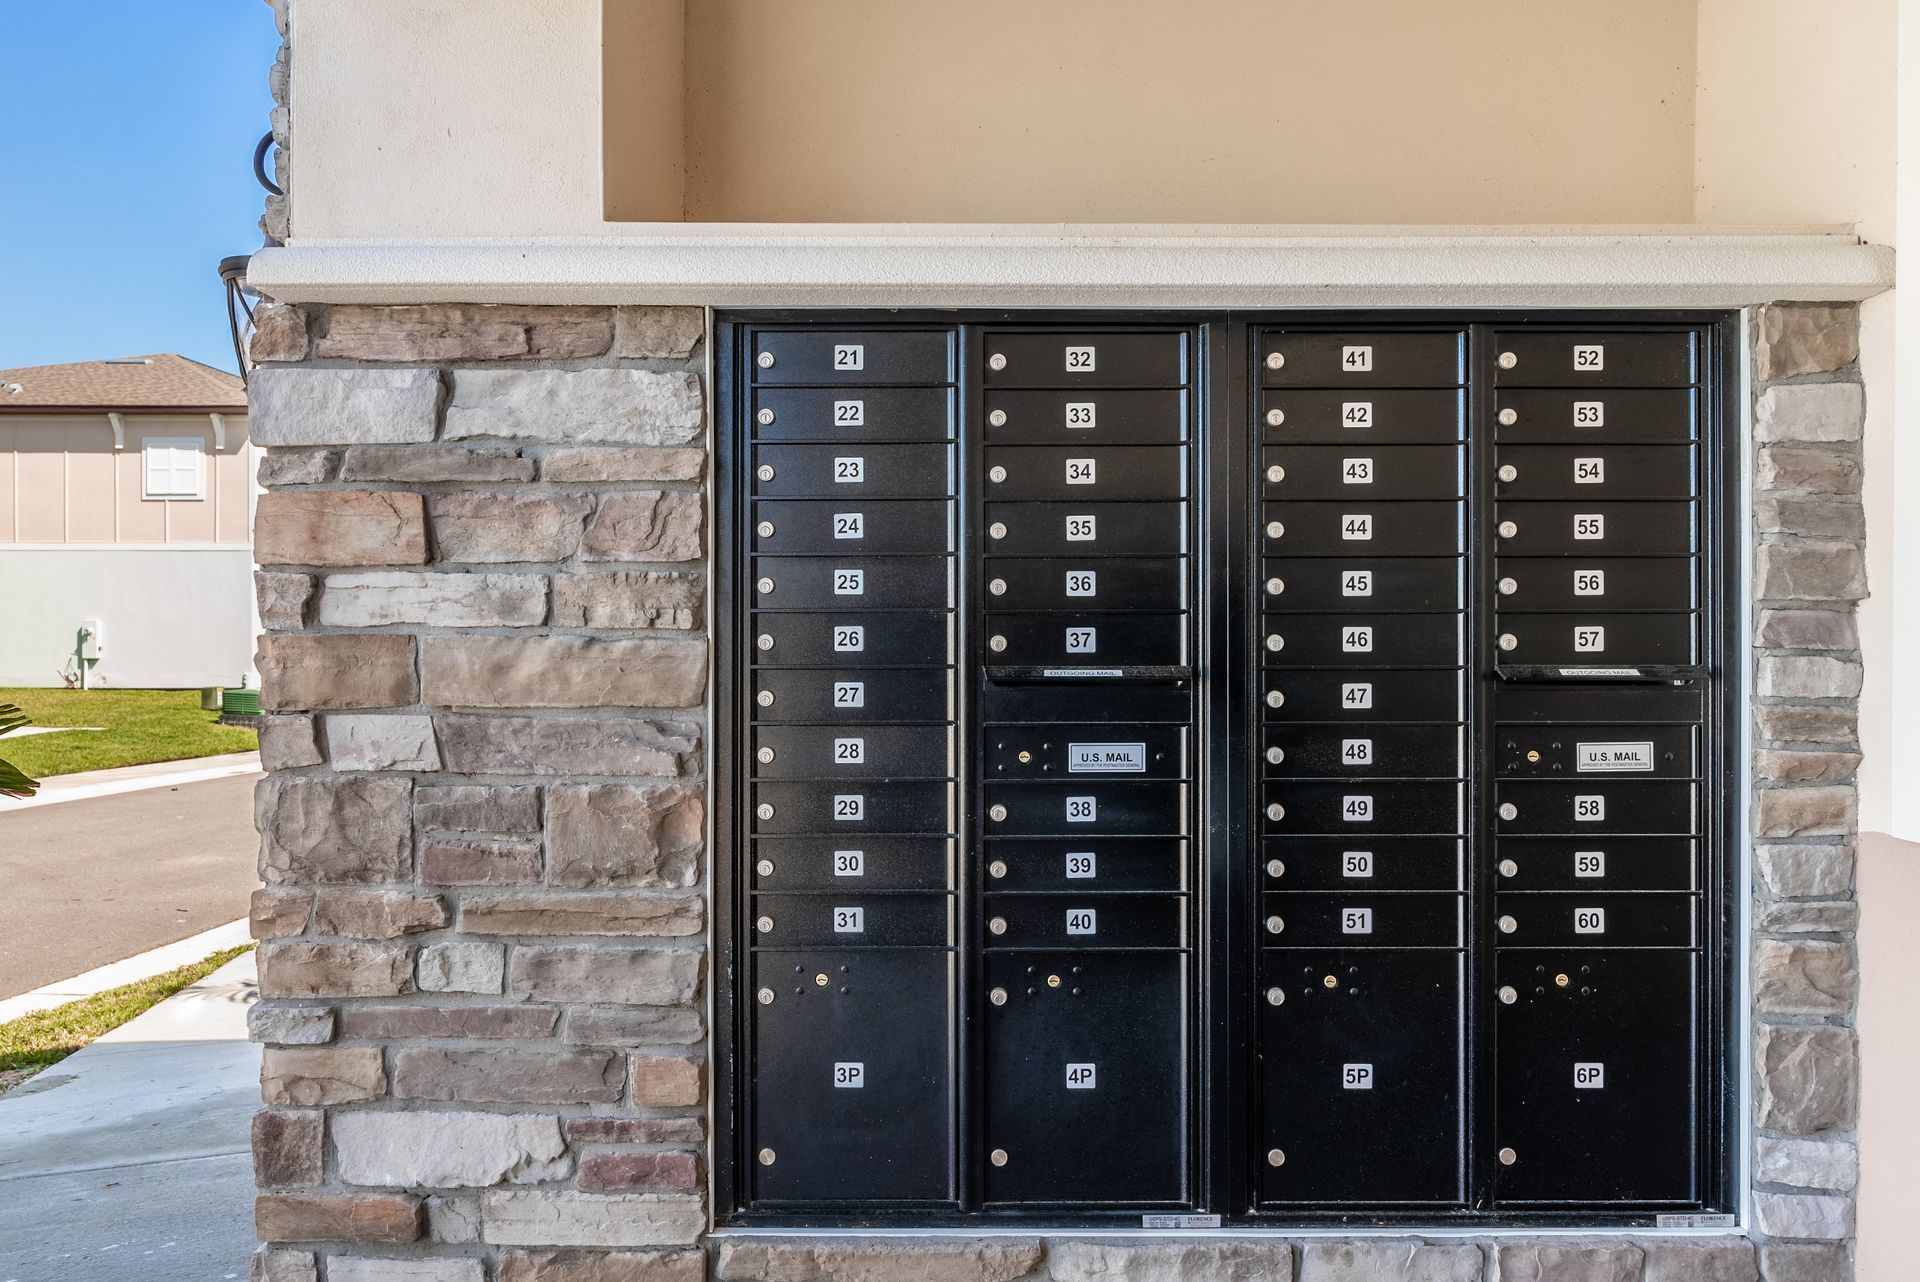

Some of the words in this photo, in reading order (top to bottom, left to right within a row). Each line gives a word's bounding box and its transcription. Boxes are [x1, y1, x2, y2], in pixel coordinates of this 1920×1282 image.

[837, 349, 857, 366] 21
[1069, 351, 1091, 368] 32
[1345, 350, 1366, 367] 41
[1577, 350, 1599, 366] 52
[837, 405, 860, 421] 22
[1069, 407, 1091, 424] 33
[1345, 407, 1368, 423] 42
[1577, 406, 1599, 423] 53
[837, 462, 860, 478] 23
[1069, 463, 1092, 480] 34
[1346, 463, 1368, 479] 43
[1578, 462, 1600, 479] 54
[837, 517, 860, 534] 24
[1069, 520, 1092, 536] 35
[1345, 519, 1368, 535] 44
[1577, 519, 1600, 535] 55
[837, 574, 860, 590] 25
[1069, 575, 1092, 592] 36
[1345, 575, 1368, 592] 45
[1578, 574, 1600, 591] 56
[837, 630, 860, 647] 26
[1069, 632, 1092, 649] 37
[1345, 631, 1368, 648] 46
[1578, 631, 1600, 647] 57
[837, 686, 860, 703] 27
[1345, 687, 1368, 704] 47
[837, 743, 860, 759] 28
[1081, 753, 1103, 762] U.S.
[1105, 753, 1133, 762] MAIL
[1344, 743, 1368, 760] 48
[1589, 752, 1611, 761] U.S.
[1614, 752, 1641, 761] MAIL
[837, 799, 859, 816] 29
[1069, 801, 1092, 818] 38
[1345, 800, 1368, 817] 49
[1578, 800, 1600, 817] 58
[837, 855, 859, 872] 30
[1069, 857, 1092, 874] 39
[1346, 856, 1368, 873] 50
[1578, 856, 1600, 873] 59
[837, 911, 857, 928] 31
[1069, 913, 1092, 930] 40
[1345, 912, 1366, 929] 51
[1578, 912, 1600, 929] 60
[836, 1067, 861, 1083] 3P
[1068, 1068, 1093, 1084] 4P
[1345, 1068, 1370, 1085] 5P
[1576, 1067, 1601, 1084] 6P
